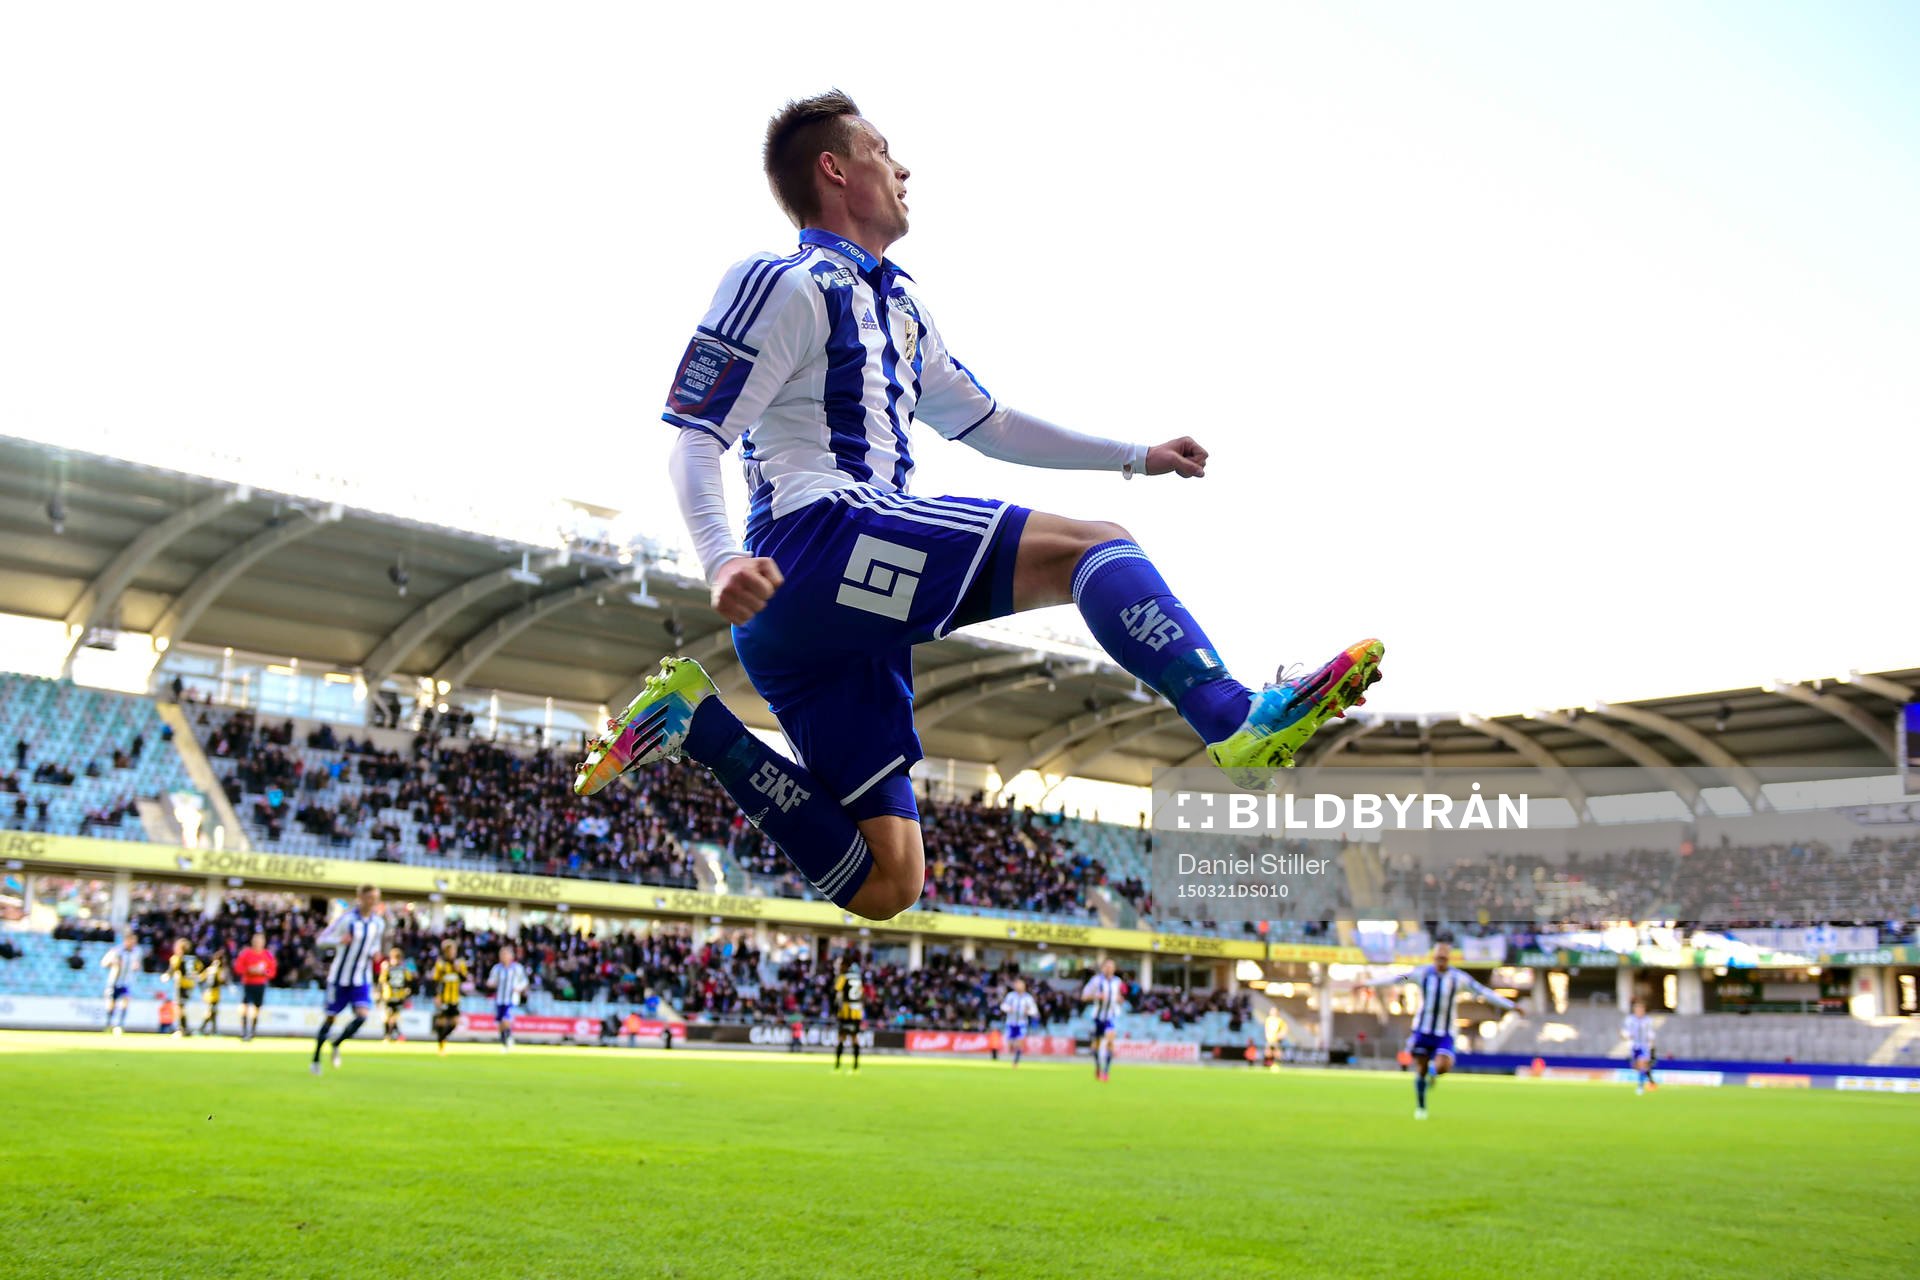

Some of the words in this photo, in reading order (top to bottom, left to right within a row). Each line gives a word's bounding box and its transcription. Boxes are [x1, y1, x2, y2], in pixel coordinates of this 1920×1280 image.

[861, 323, 878, 331] adidas
[689, 361, 719, 378] SVERIGES
[698, 356, 717, 368] HELA
[684, 368, 716, 386] FOTBOLLS
[1119, 599, 1184, 652] SKF
[749, 760, 811, 814] SKF
